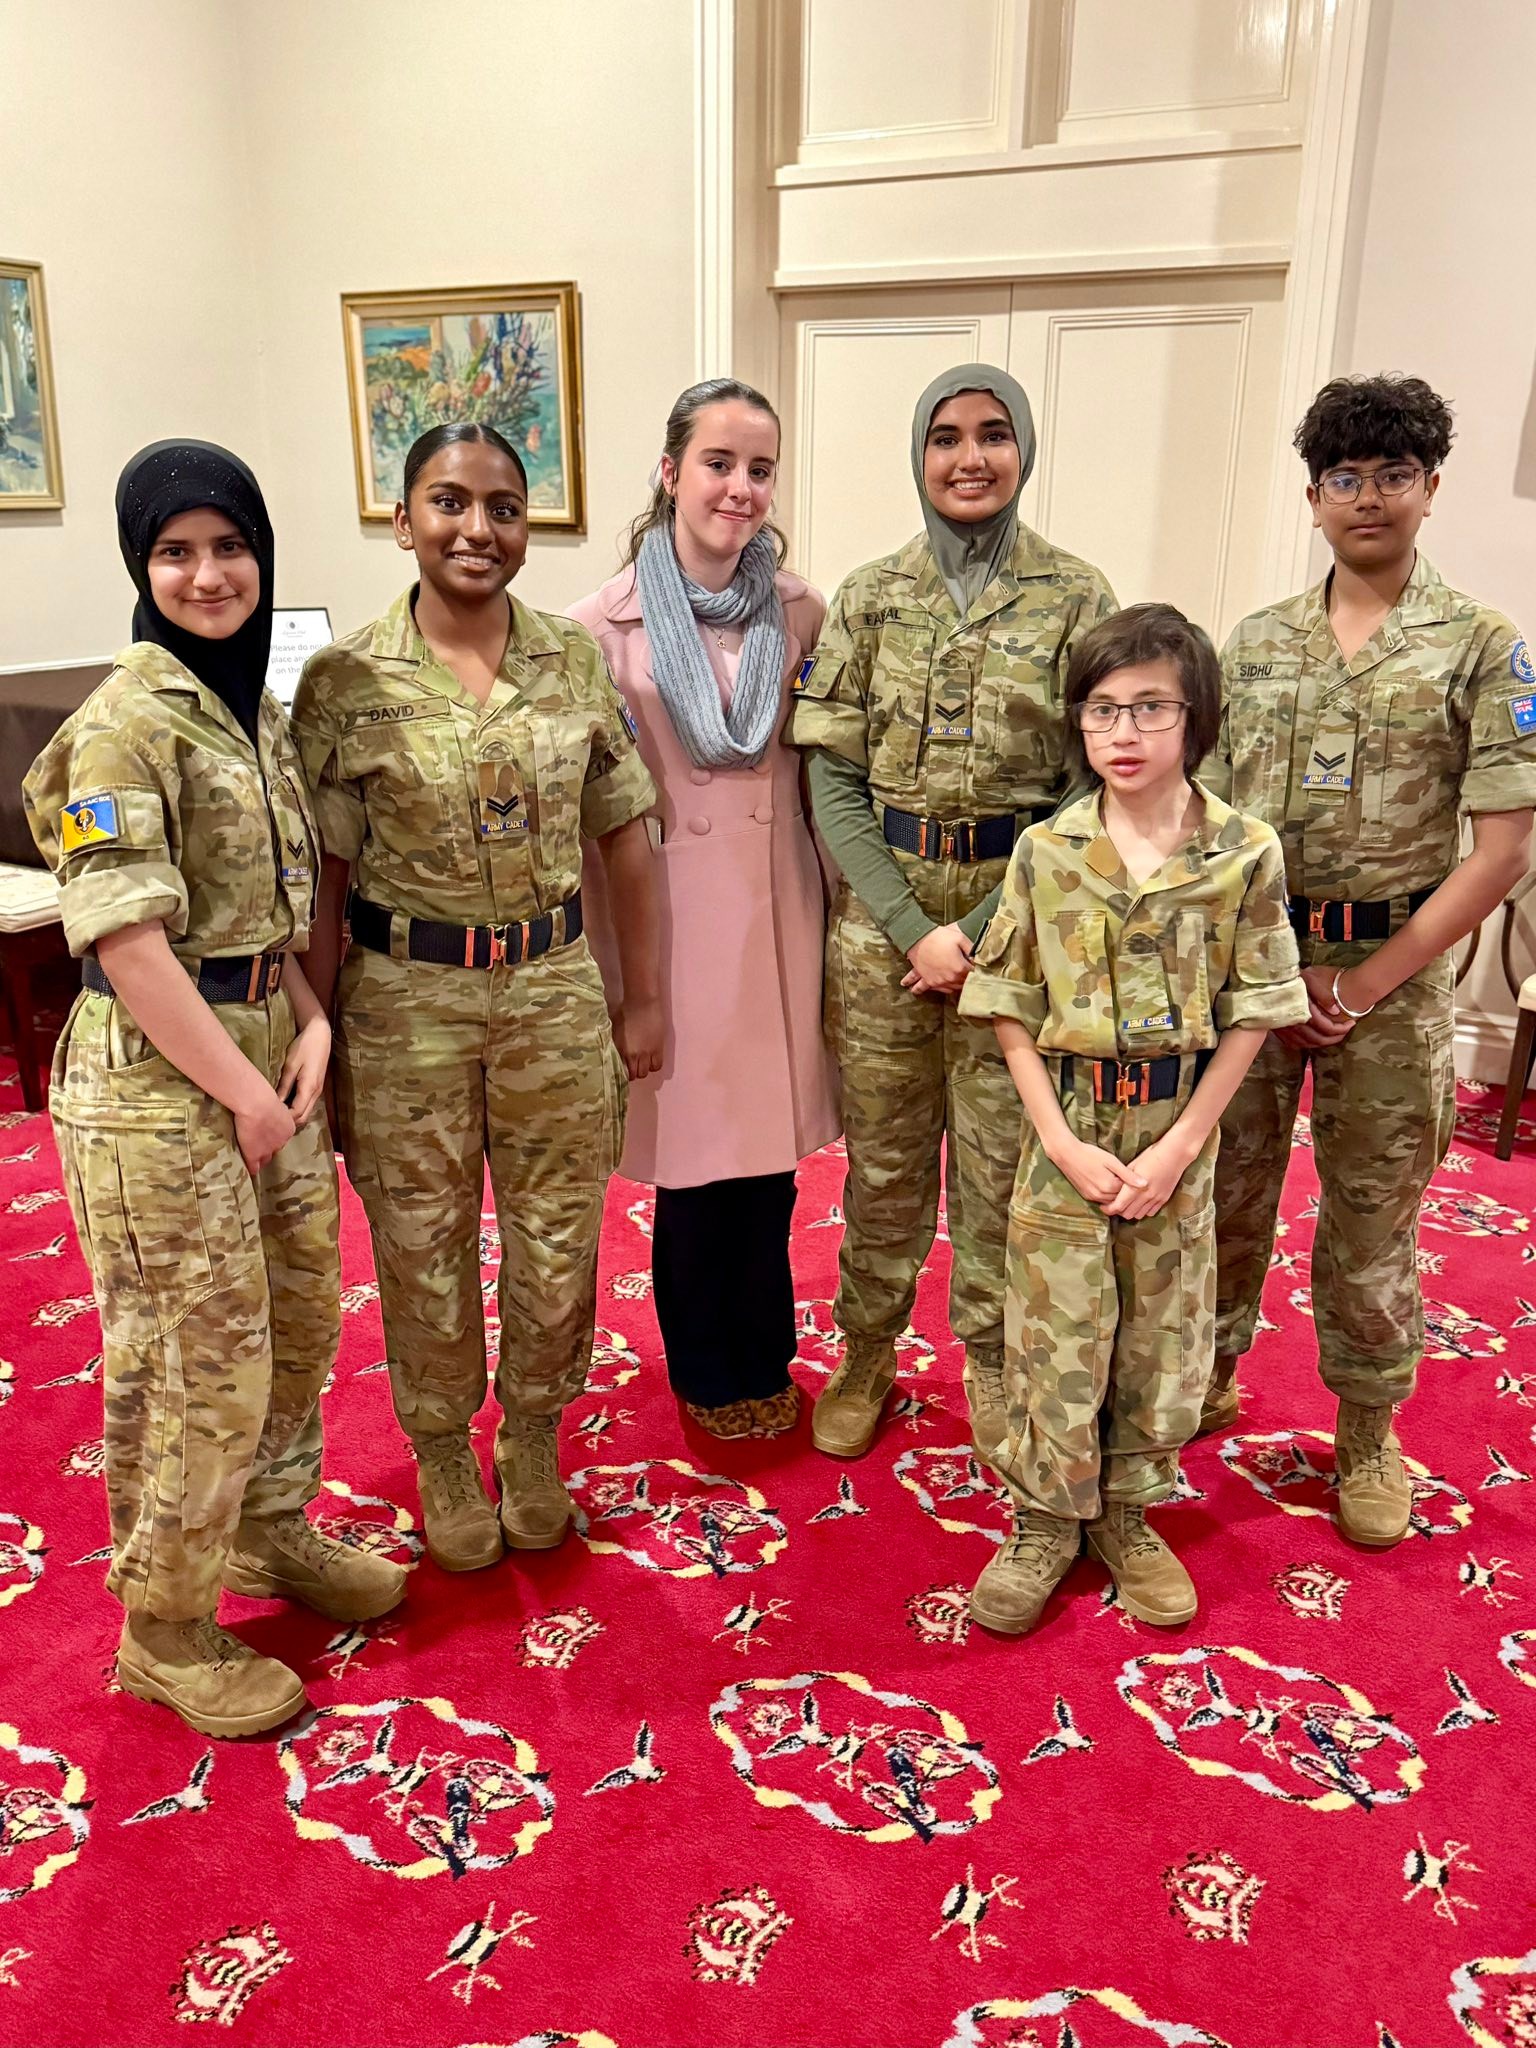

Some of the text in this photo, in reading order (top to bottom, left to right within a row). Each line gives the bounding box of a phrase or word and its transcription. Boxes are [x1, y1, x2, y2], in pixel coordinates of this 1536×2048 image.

[271, 656, 292, 664] place
[288, 666, 301, 674] the
[1240, 665, 1273, 677] SIDHU
[370, 705, 414, 721] DAVID
[931, 726, 967, 735] ARMY CADET
[1308, 775, 1345, 784] ARMY CADET
[487, 820, 524, 832] ARMY CADET
[1128, 1016, 1167, 1028] ARMY CADET
